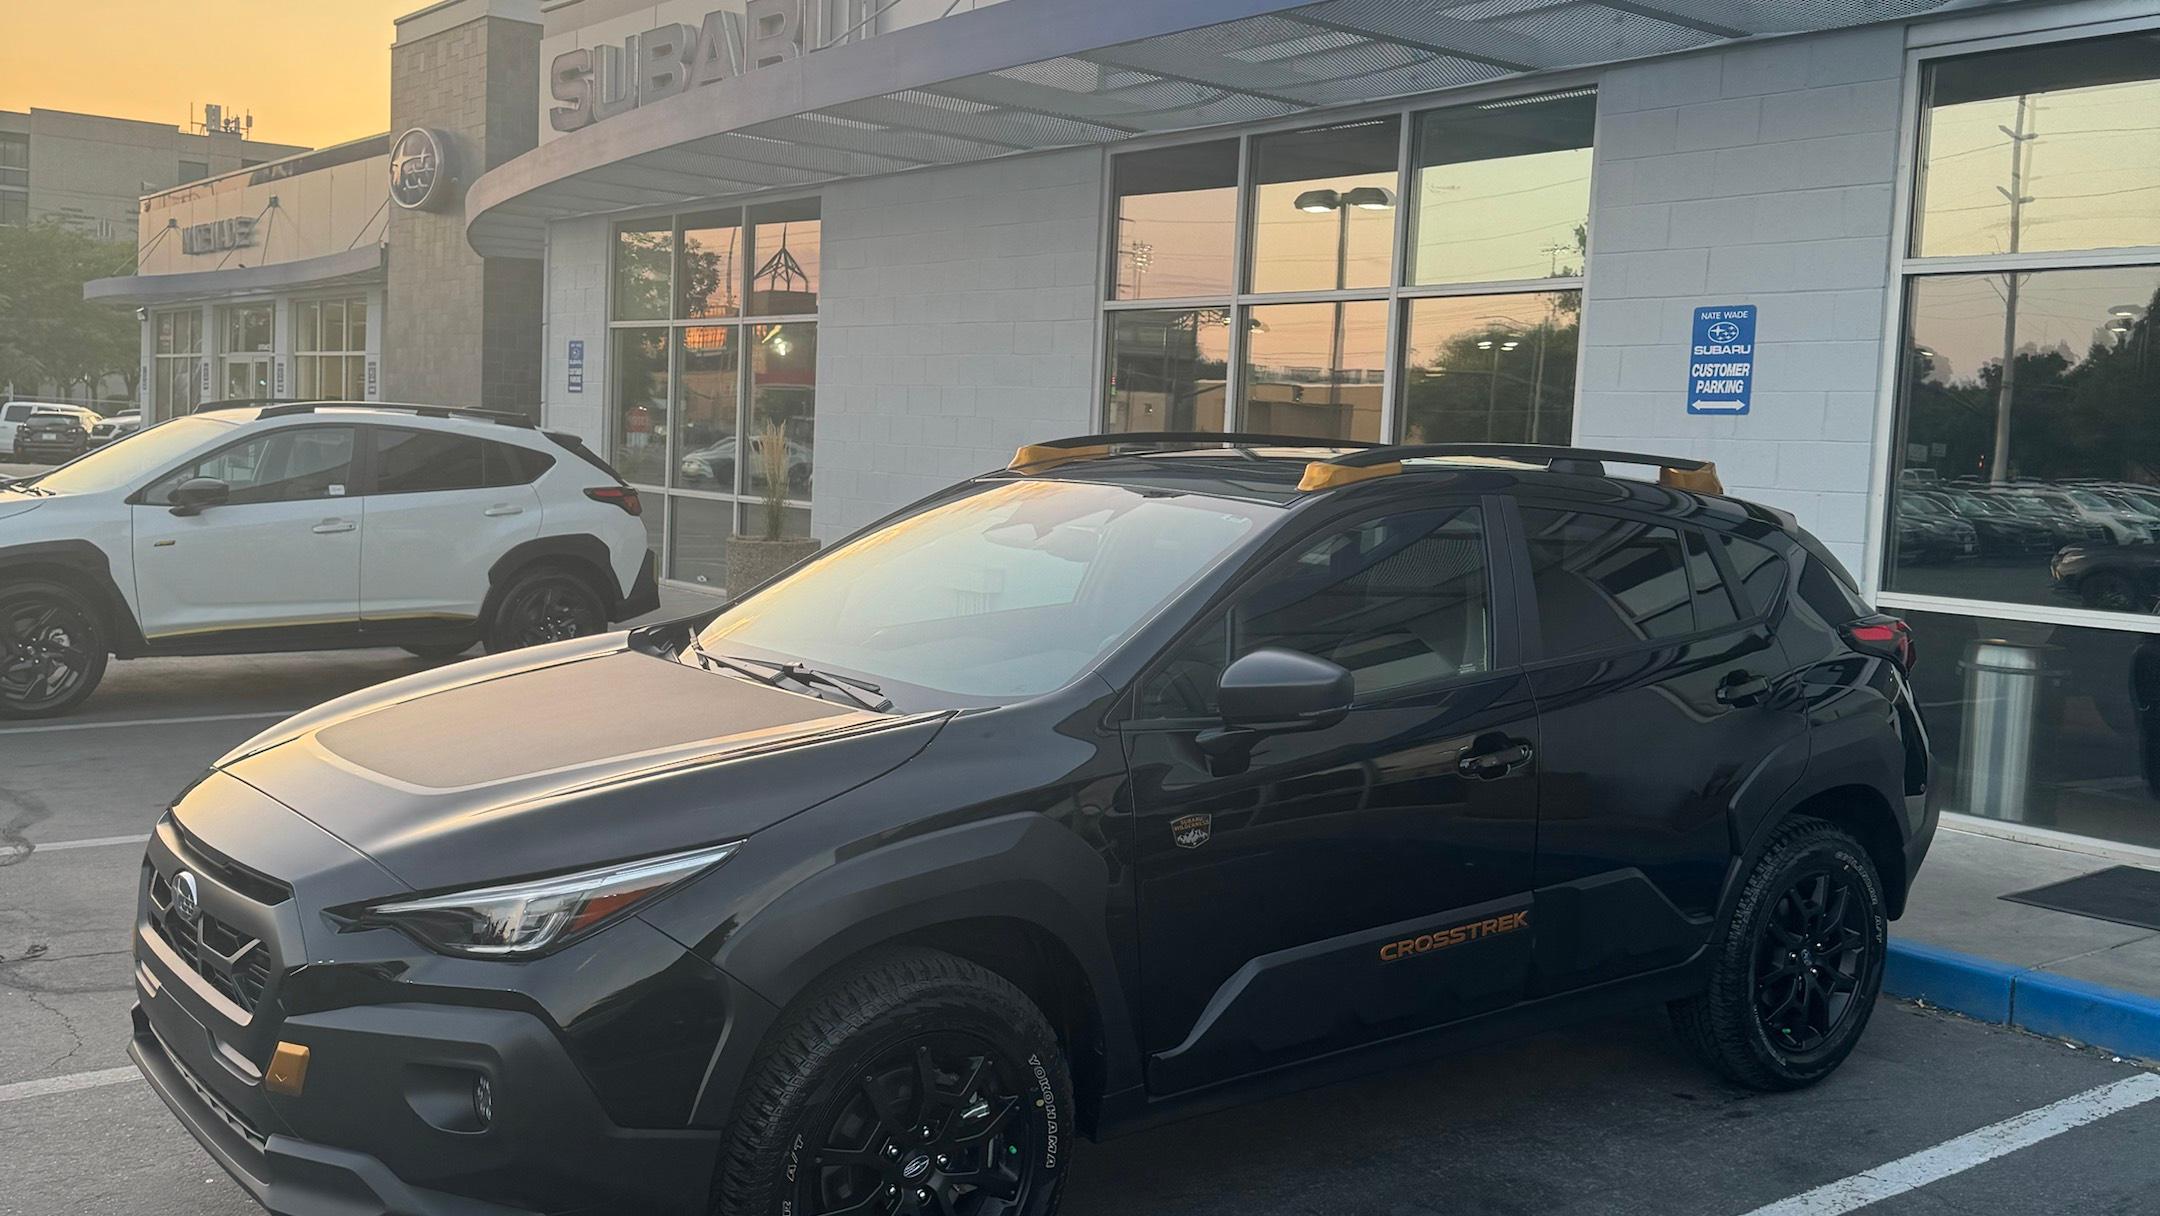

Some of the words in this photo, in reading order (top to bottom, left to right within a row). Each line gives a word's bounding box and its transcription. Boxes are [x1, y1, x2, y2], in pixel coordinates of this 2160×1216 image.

[1701, 312, 1721, 320] NATE
[1724, 310, 1748, 319] WADE
[1693, 345, 1752, 355] SUBARU
[1691, 363, 1750, 378] CUSTOMER
[1695, 380, 1744, 394] PARKING
[1380, 910, 1529, 961] CROSSTREK
[1028, 1053, 1059, 1169] YOKOHAMA
